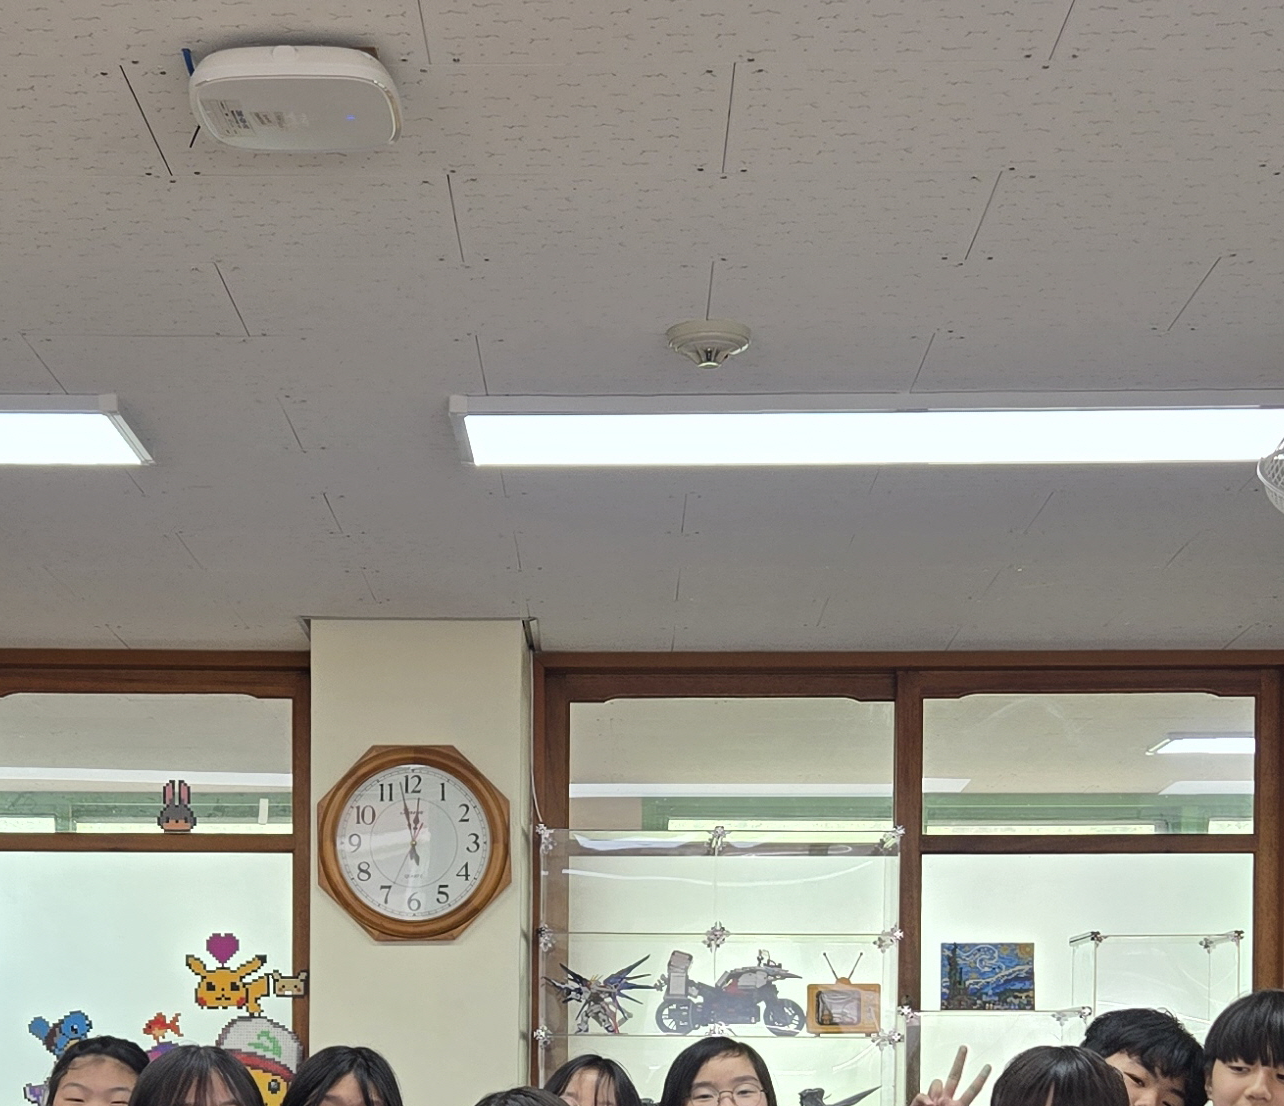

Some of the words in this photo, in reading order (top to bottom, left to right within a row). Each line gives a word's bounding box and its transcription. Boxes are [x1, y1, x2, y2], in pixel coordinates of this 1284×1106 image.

[379, 783, 393, 802] 11
[404, 775, 422, 794] 12
[440, 783, 446, 801] 1
[355, 805, 376, 825] 10
[458, 804, 470, 823] 2
[348, 833, 362, 853] 9
[466, 833, 480, 853] 3
[357, 861, 372, 881] 8
[456, 861, 470, 881] 4
[379, 885, 393, 904] 7
[407, 892, 422, 911] 6
[436, 885, 449, 904] 5
